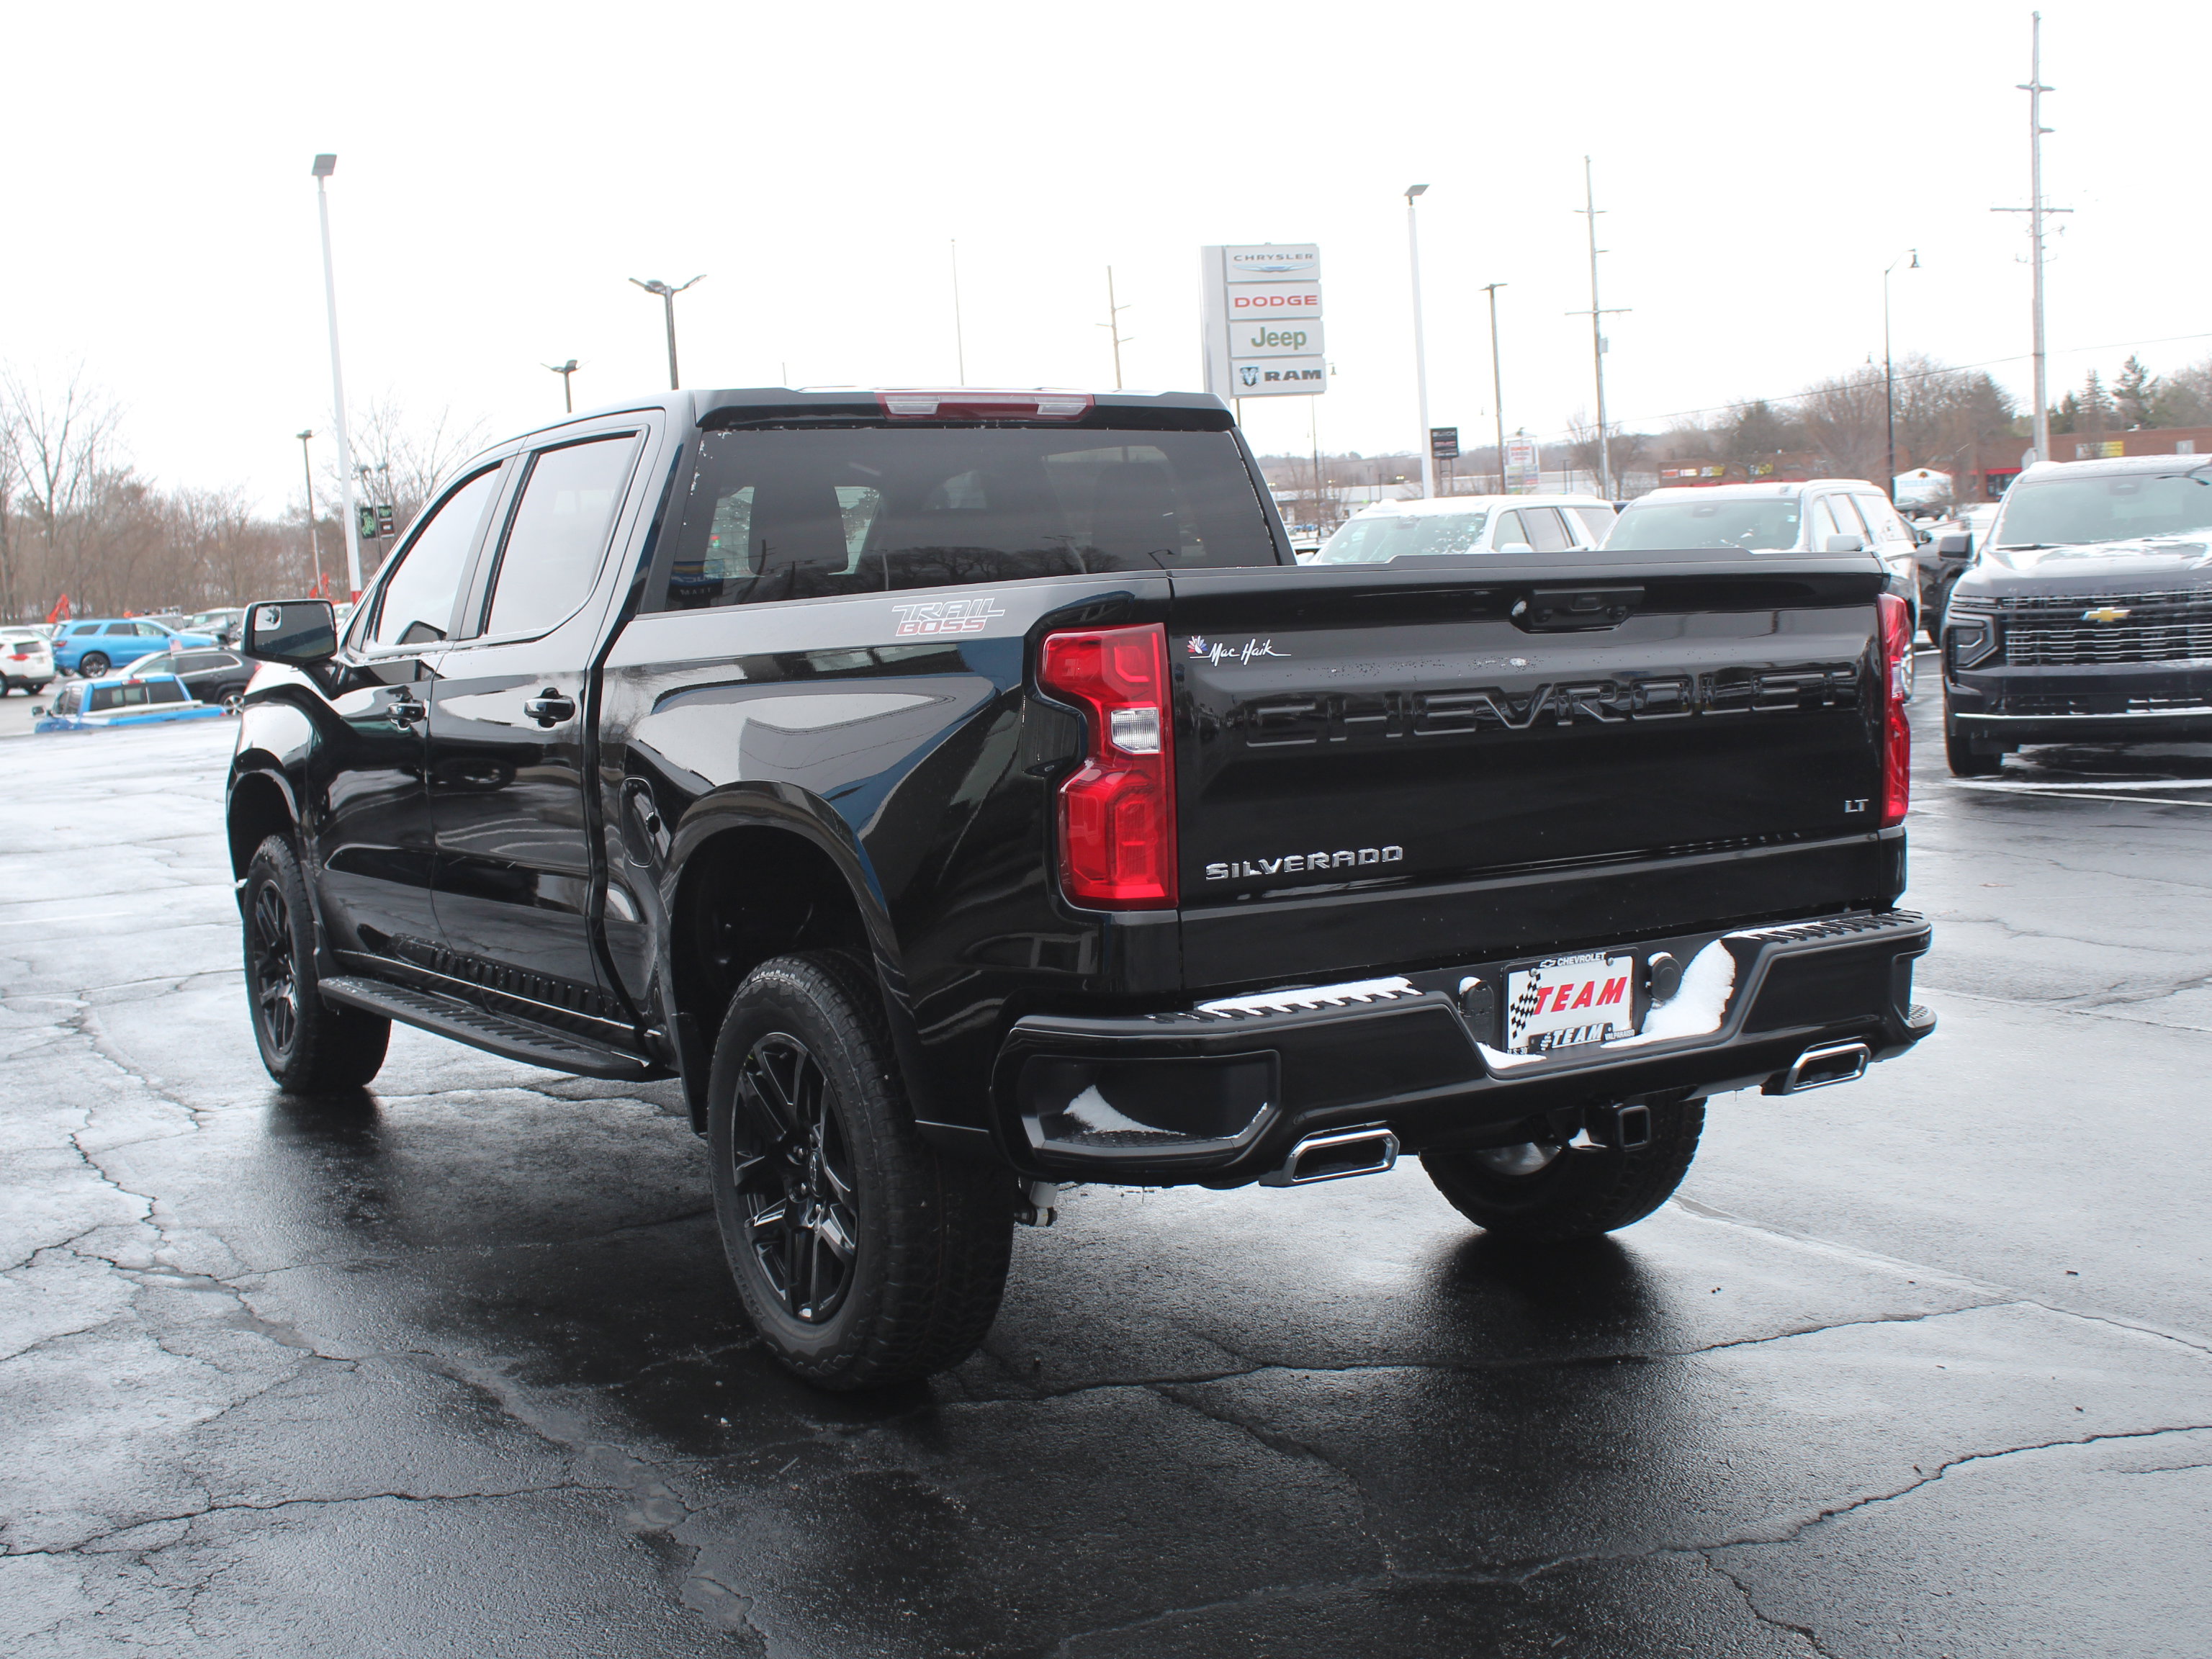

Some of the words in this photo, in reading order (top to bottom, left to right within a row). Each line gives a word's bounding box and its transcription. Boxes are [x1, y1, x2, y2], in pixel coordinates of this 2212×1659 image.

[1234, 295, 1318, 307] DODGE
[1251, 326, 1307, 350] Jeep
[1264, 369, 1322, 382] RAM
[891, 598, 1006, 622] TRAIL
[896, 616, 988, 637] BOSS
[1201, 642, 1240, 667] Mac
[1241, 638, 1283, 666] Haik
[1245, 669, 1856, 747] CHEVROLET
[1845, 799, 1869, 813] LT
[1205, 845, 1403, 881] SILVERADO
[1557, 952, 1606, 966] CHEVROLET
[1532, 976, 1628, 1015] TEAM
[1551, 1023, 1604, 1047] TEAM
